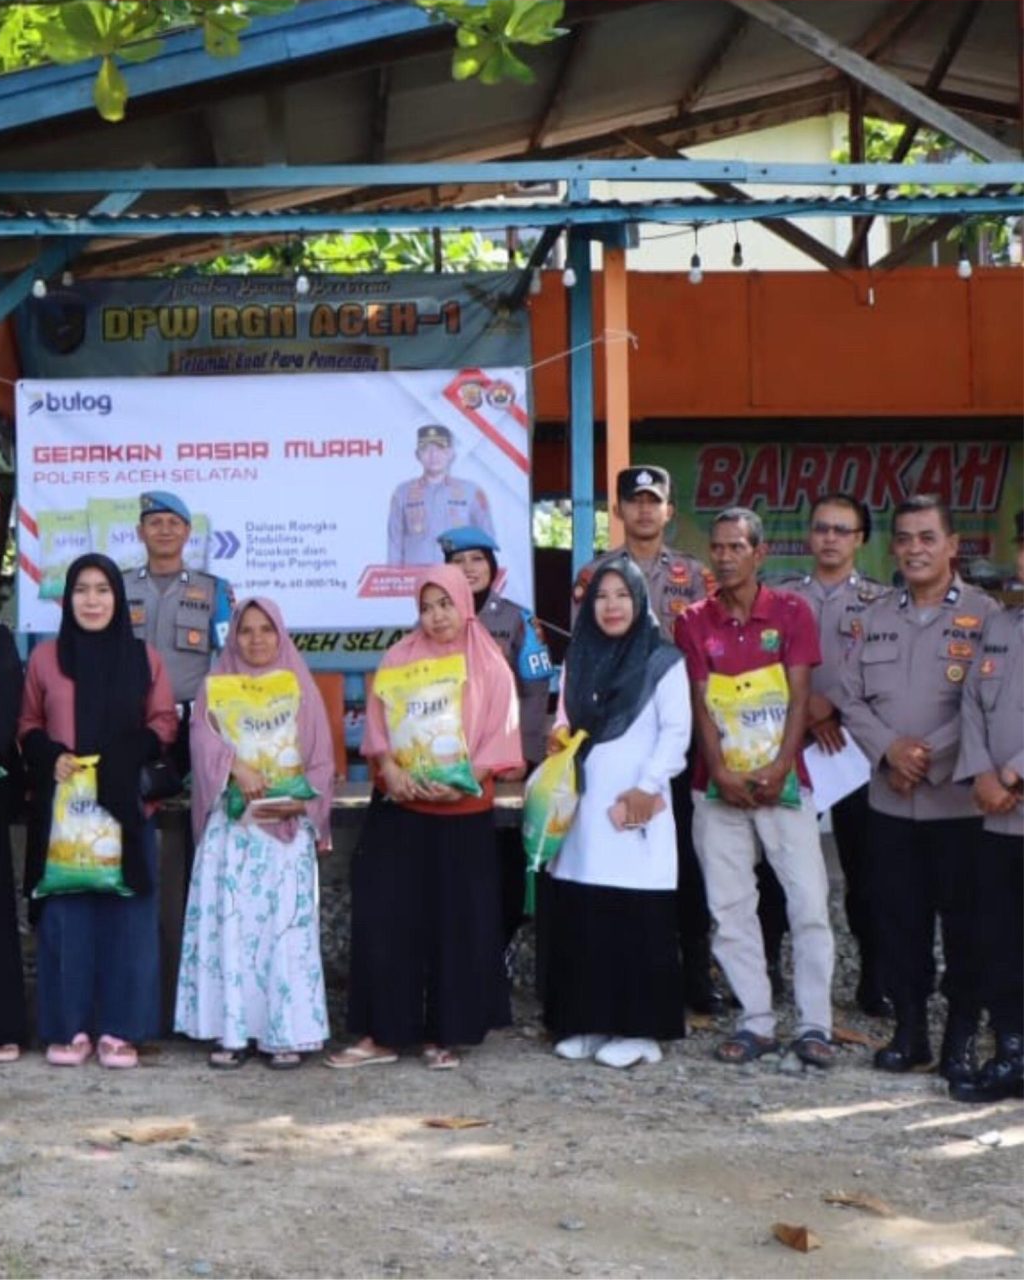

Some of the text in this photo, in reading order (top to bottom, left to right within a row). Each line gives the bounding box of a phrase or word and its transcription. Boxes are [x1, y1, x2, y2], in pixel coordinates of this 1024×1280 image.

[102, 299, 462, 342] DPW RGN ACEH-1
[46, 392, 112, 415] bulog
[33, 439, 383, 464] GERAKAN PASAR MURAH
[33, 467, 258, 485] POLRES ACEH SELATAN
[693, 443, 1008, 513] BAROKAH
[290, 632, 340, 652] CEH
